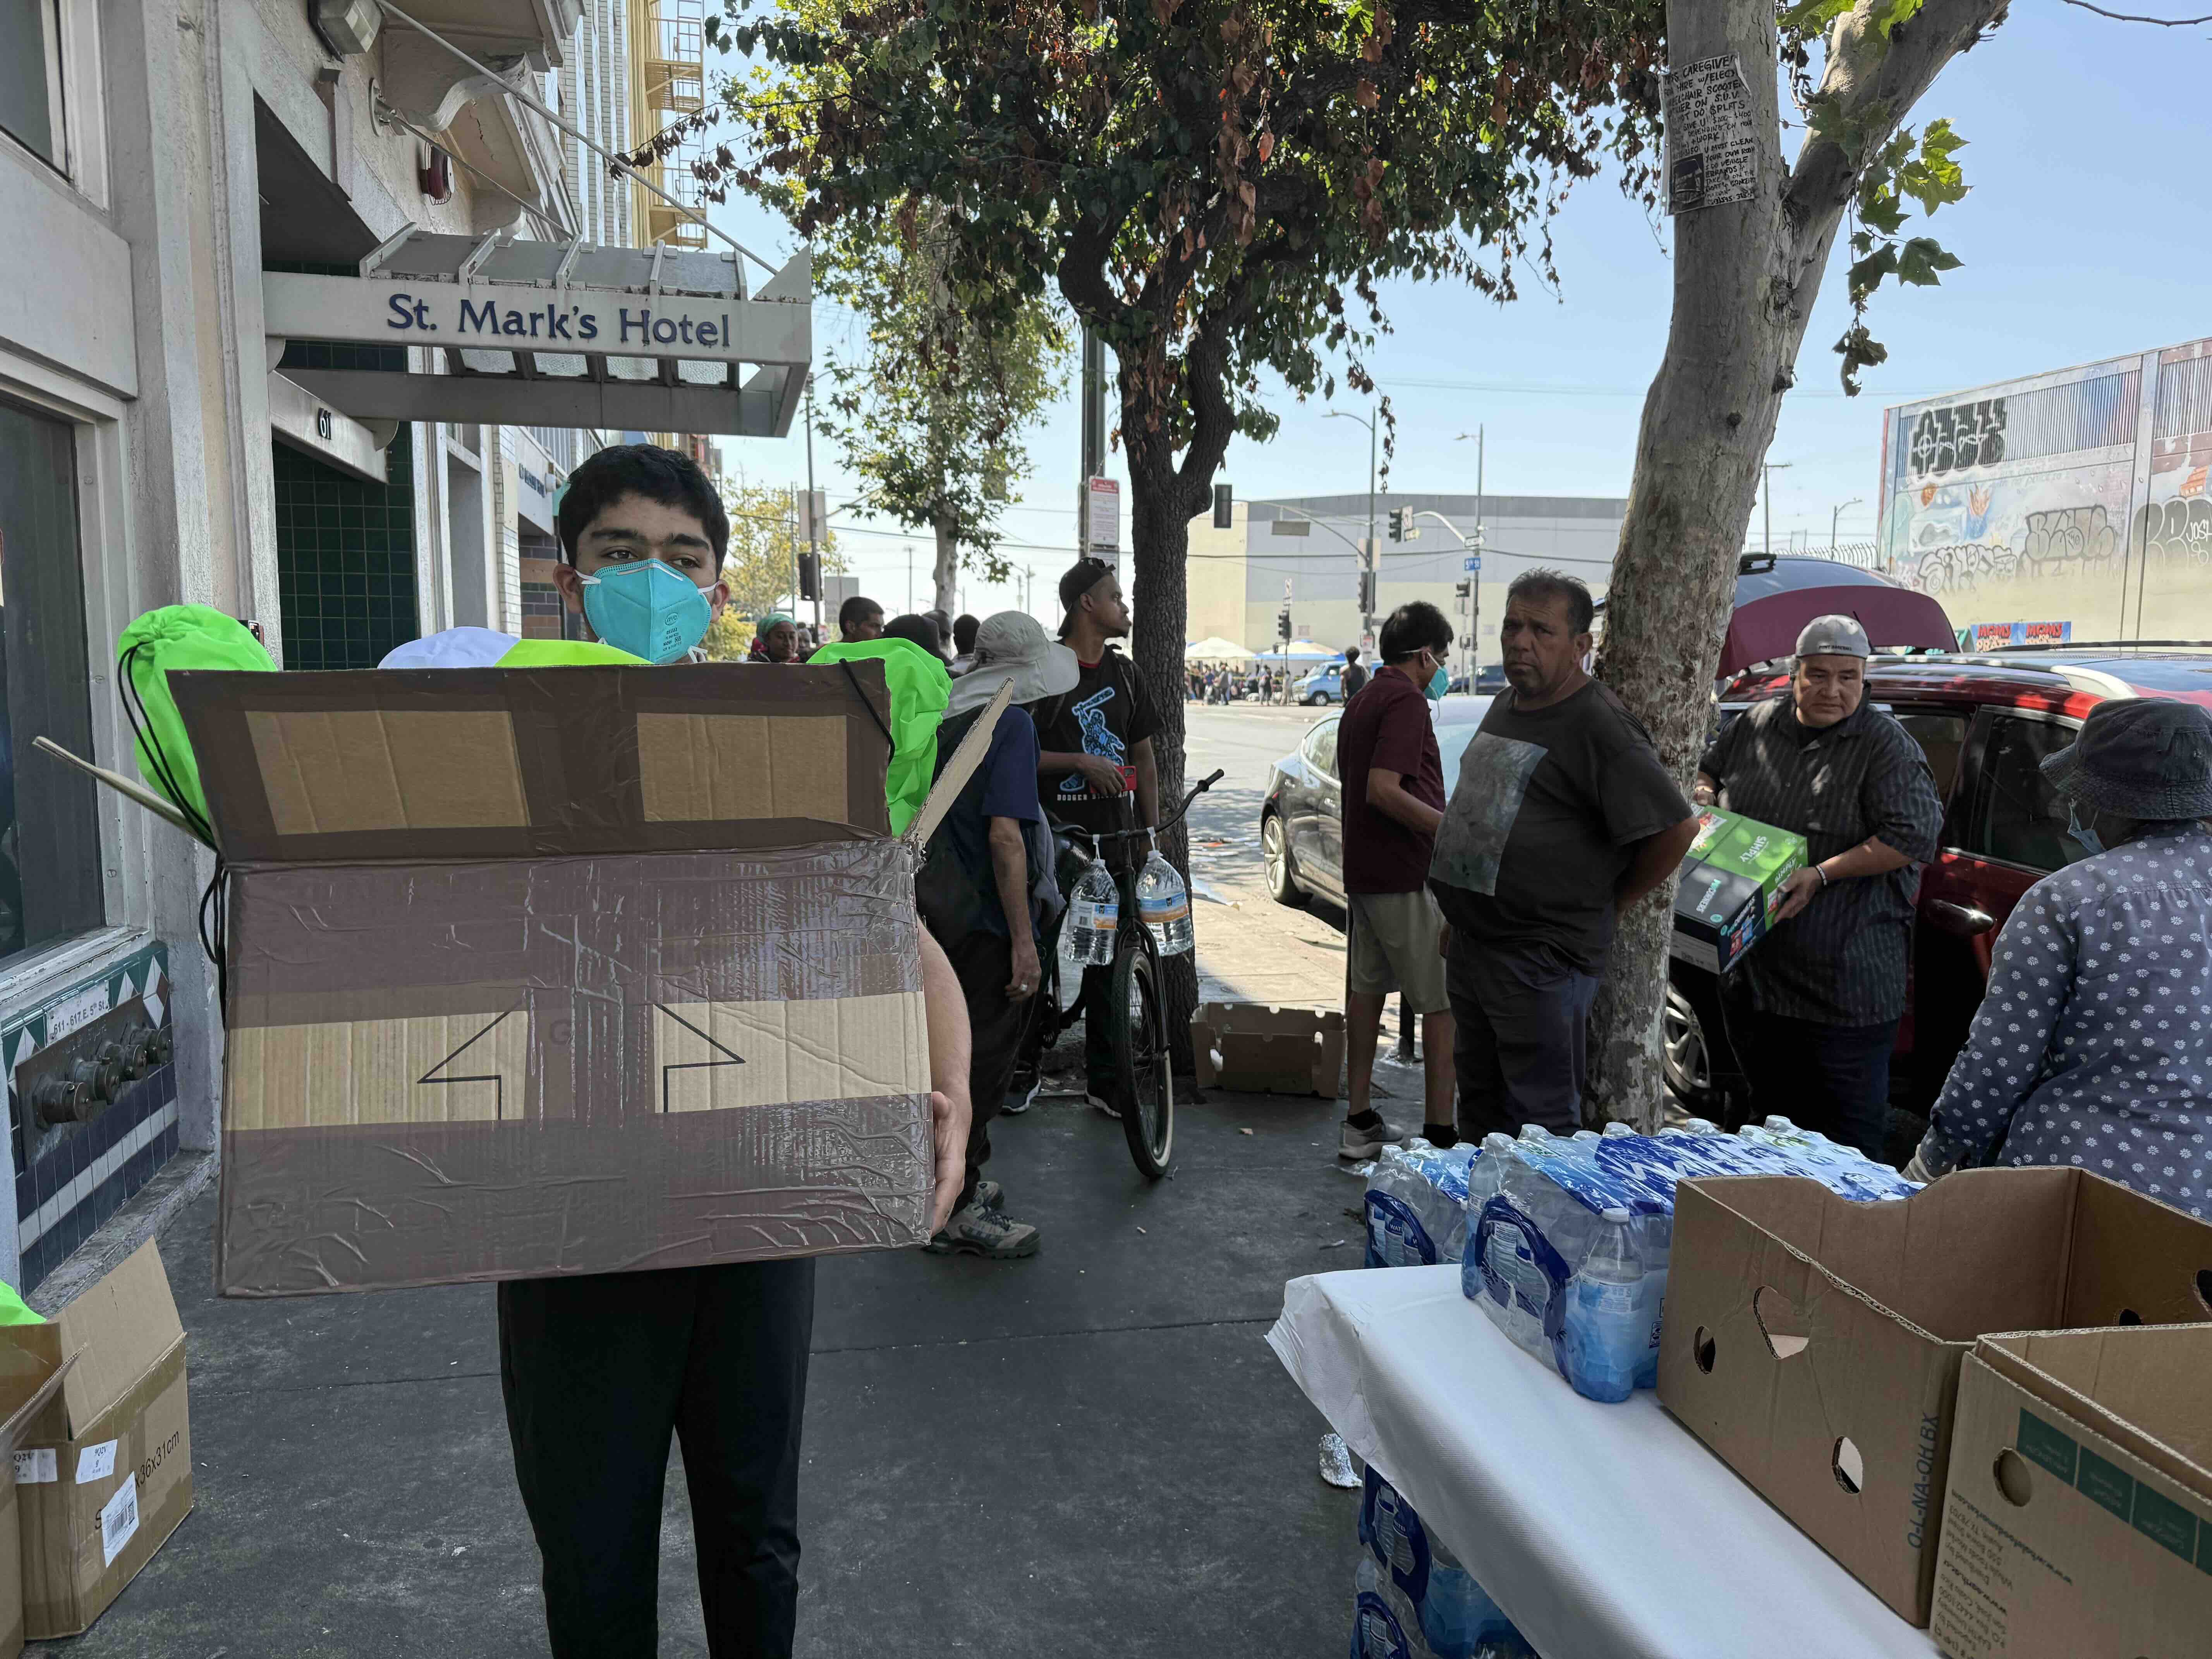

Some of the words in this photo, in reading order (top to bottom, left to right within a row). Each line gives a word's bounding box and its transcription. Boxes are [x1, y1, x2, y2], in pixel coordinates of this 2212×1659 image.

[1695, 97, 1707, 108] ON
[1730, 137, 1753, 147] CLEAN
[387, 294, 438, 332] St.
[458, 298, 599, 340] Mark's
[620, 307, 730, 348] Hotel
[318, 407, 331, 440] 611
[1977, 623, 2012, 639] MOMS
[2025, 622, 2063, 638] MOMS
[54, 1020, 65, 1035] 611
